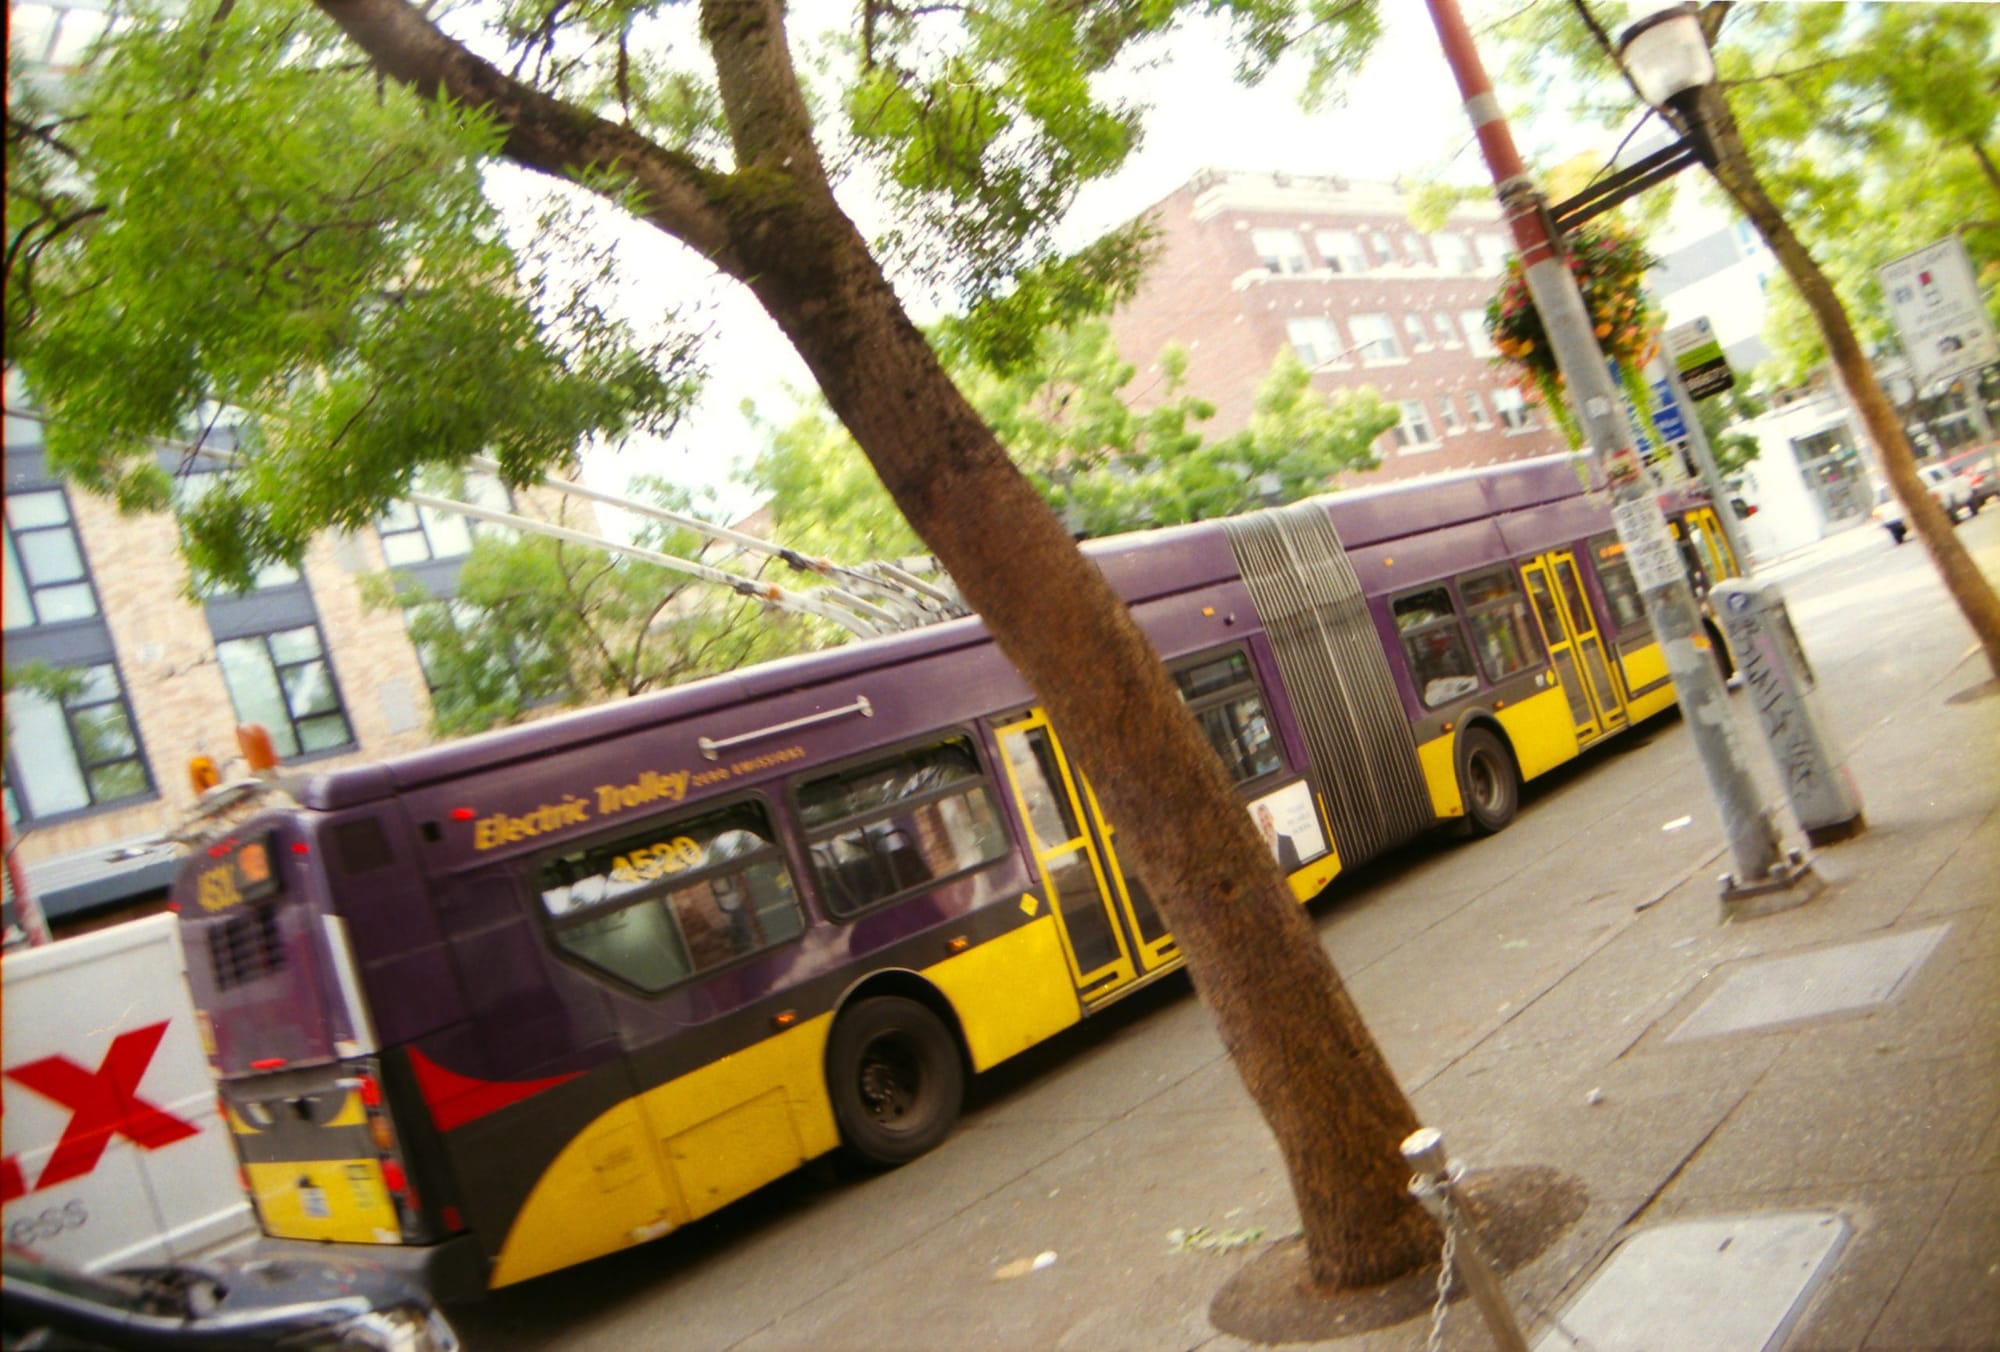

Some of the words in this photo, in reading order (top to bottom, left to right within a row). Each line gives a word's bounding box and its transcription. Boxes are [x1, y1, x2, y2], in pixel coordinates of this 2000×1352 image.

[474, 794, 590, 850] Electric
[594, 769, 690, 815] Trolley
[612, 836, 703, 883] 4520
